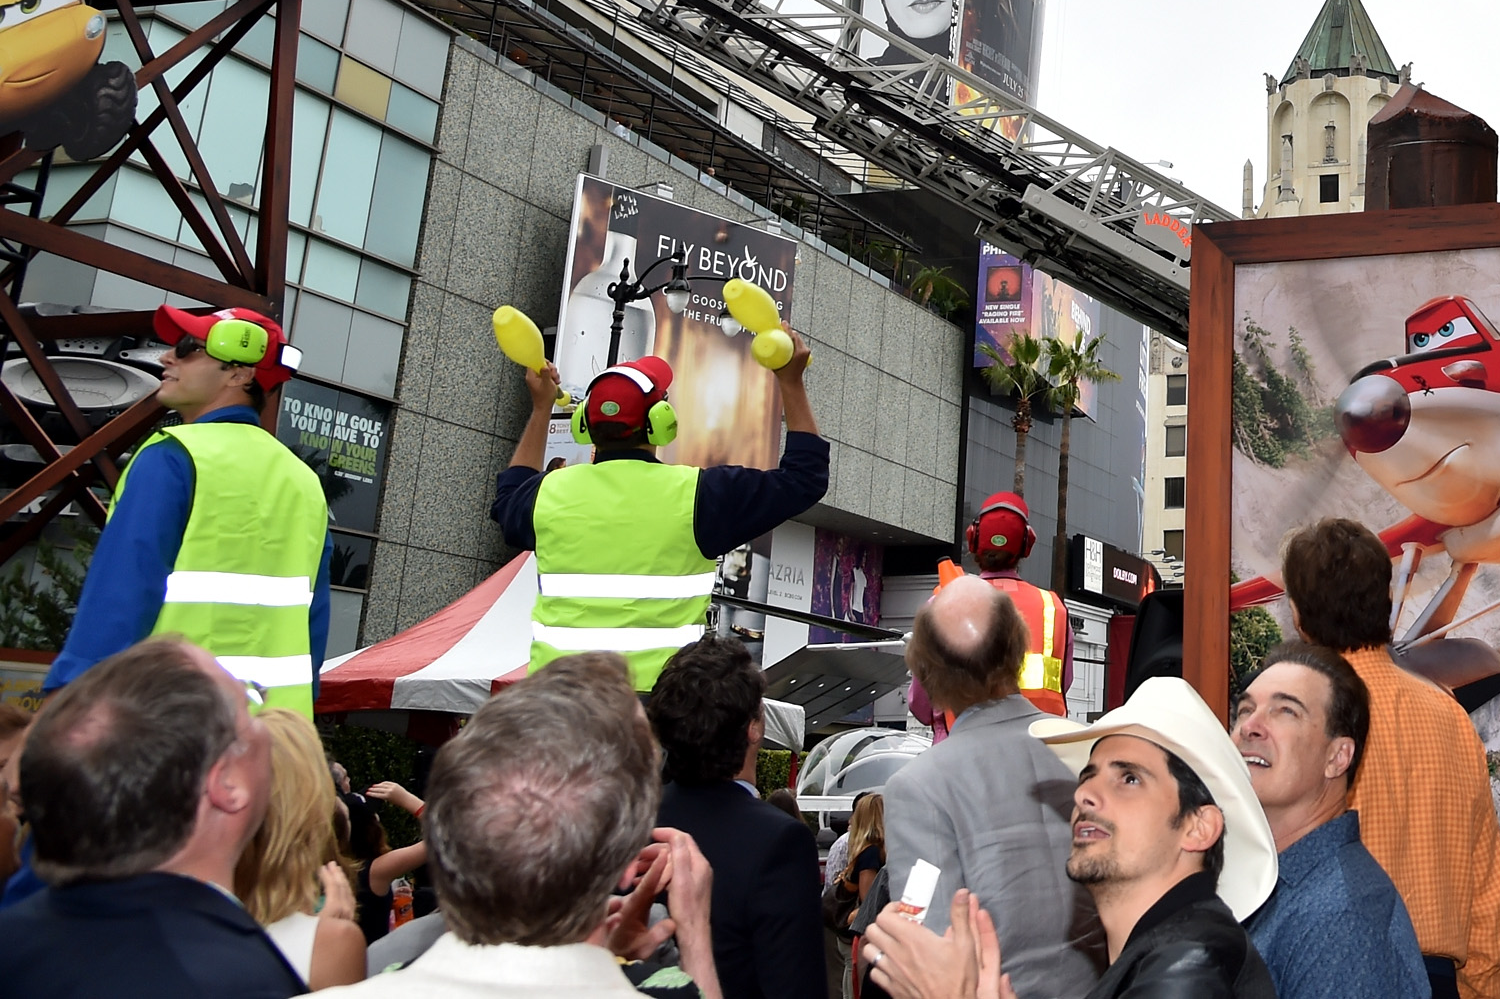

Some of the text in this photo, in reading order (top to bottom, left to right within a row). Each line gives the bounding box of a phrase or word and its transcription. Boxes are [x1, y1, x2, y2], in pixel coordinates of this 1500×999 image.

[1002, 72, 1018, 92] JULY
[657, 234, 788, 293] FLY BEYOND
[683, 308, 722, 327] THE FRU
[284, 396, 384, 437] TO KNOW GOLF,
[549, 423, 556, 434] 8
[290, 413, 380, 449] YOU HAVE TO
[300, 431, 377, 462] KNOW YOUR
[328, 452, 378, 477] GREENS.
